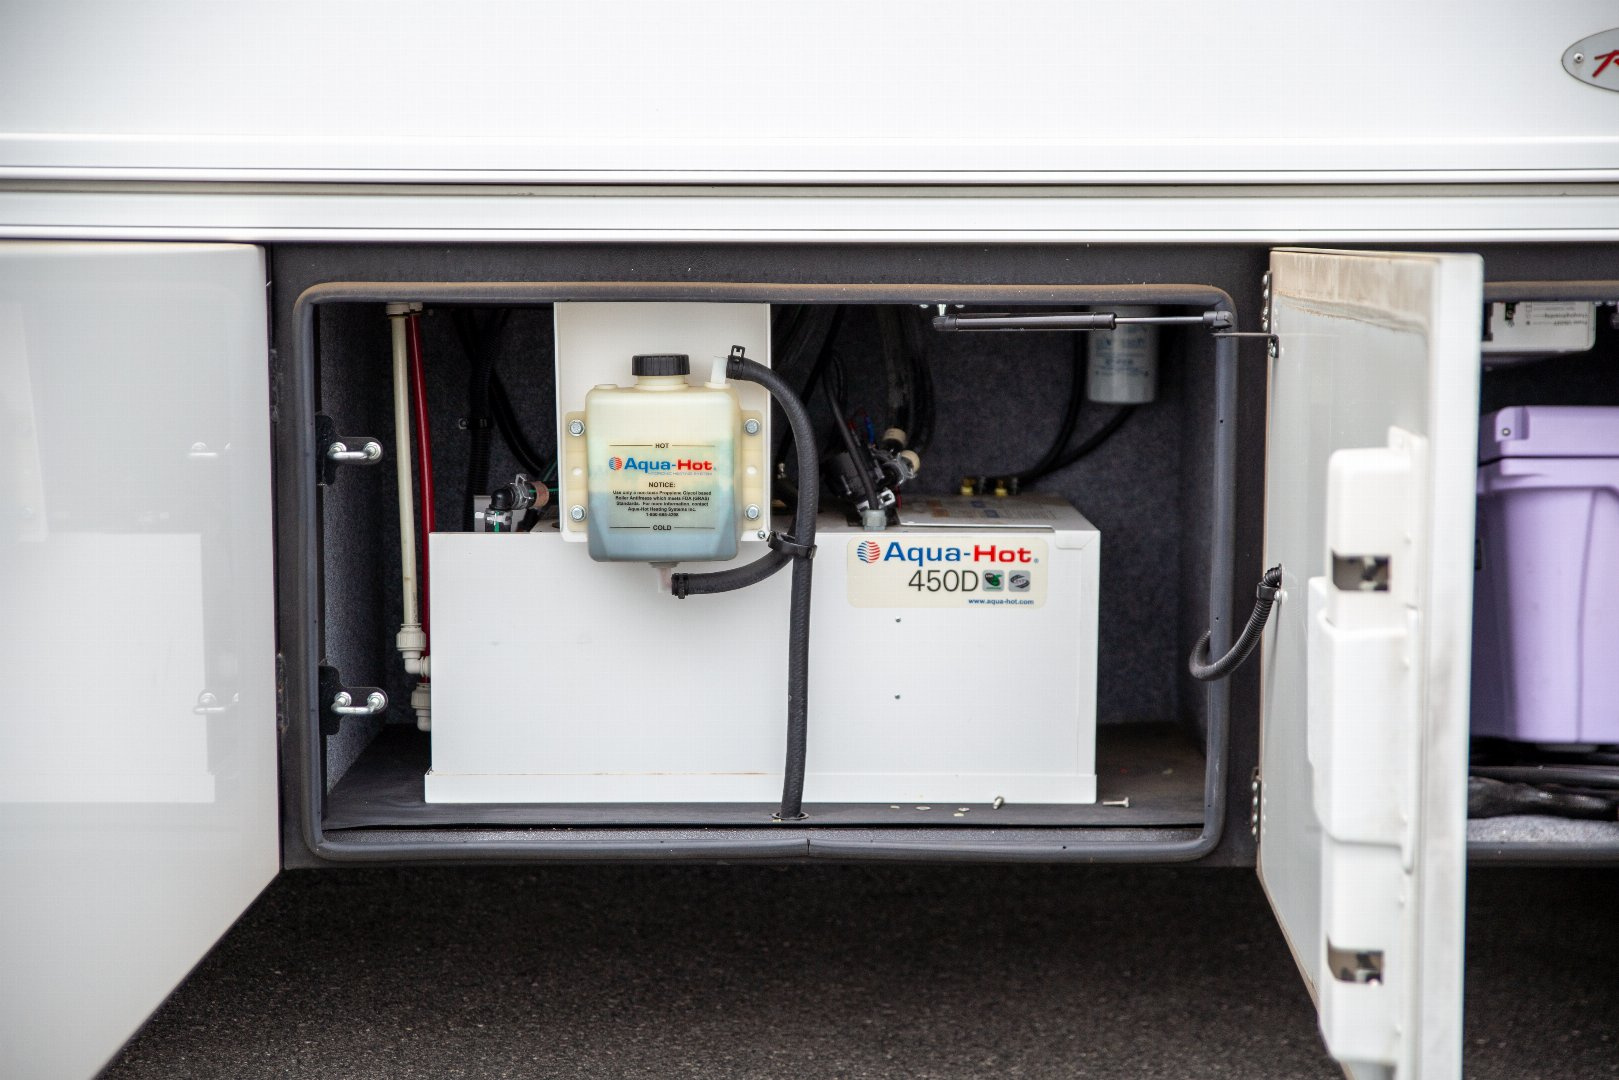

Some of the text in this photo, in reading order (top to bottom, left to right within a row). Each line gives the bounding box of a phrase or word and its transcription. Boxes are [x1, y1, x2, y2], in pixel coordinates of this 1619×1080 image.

[624, 457, 713, 474] Aqua-Hot
[884, 541, 1032, 567] Aqua-Hot
[908, 569, 979, 592] 450D
[968, 598, 1034, 606] www.aqua-hot.com
